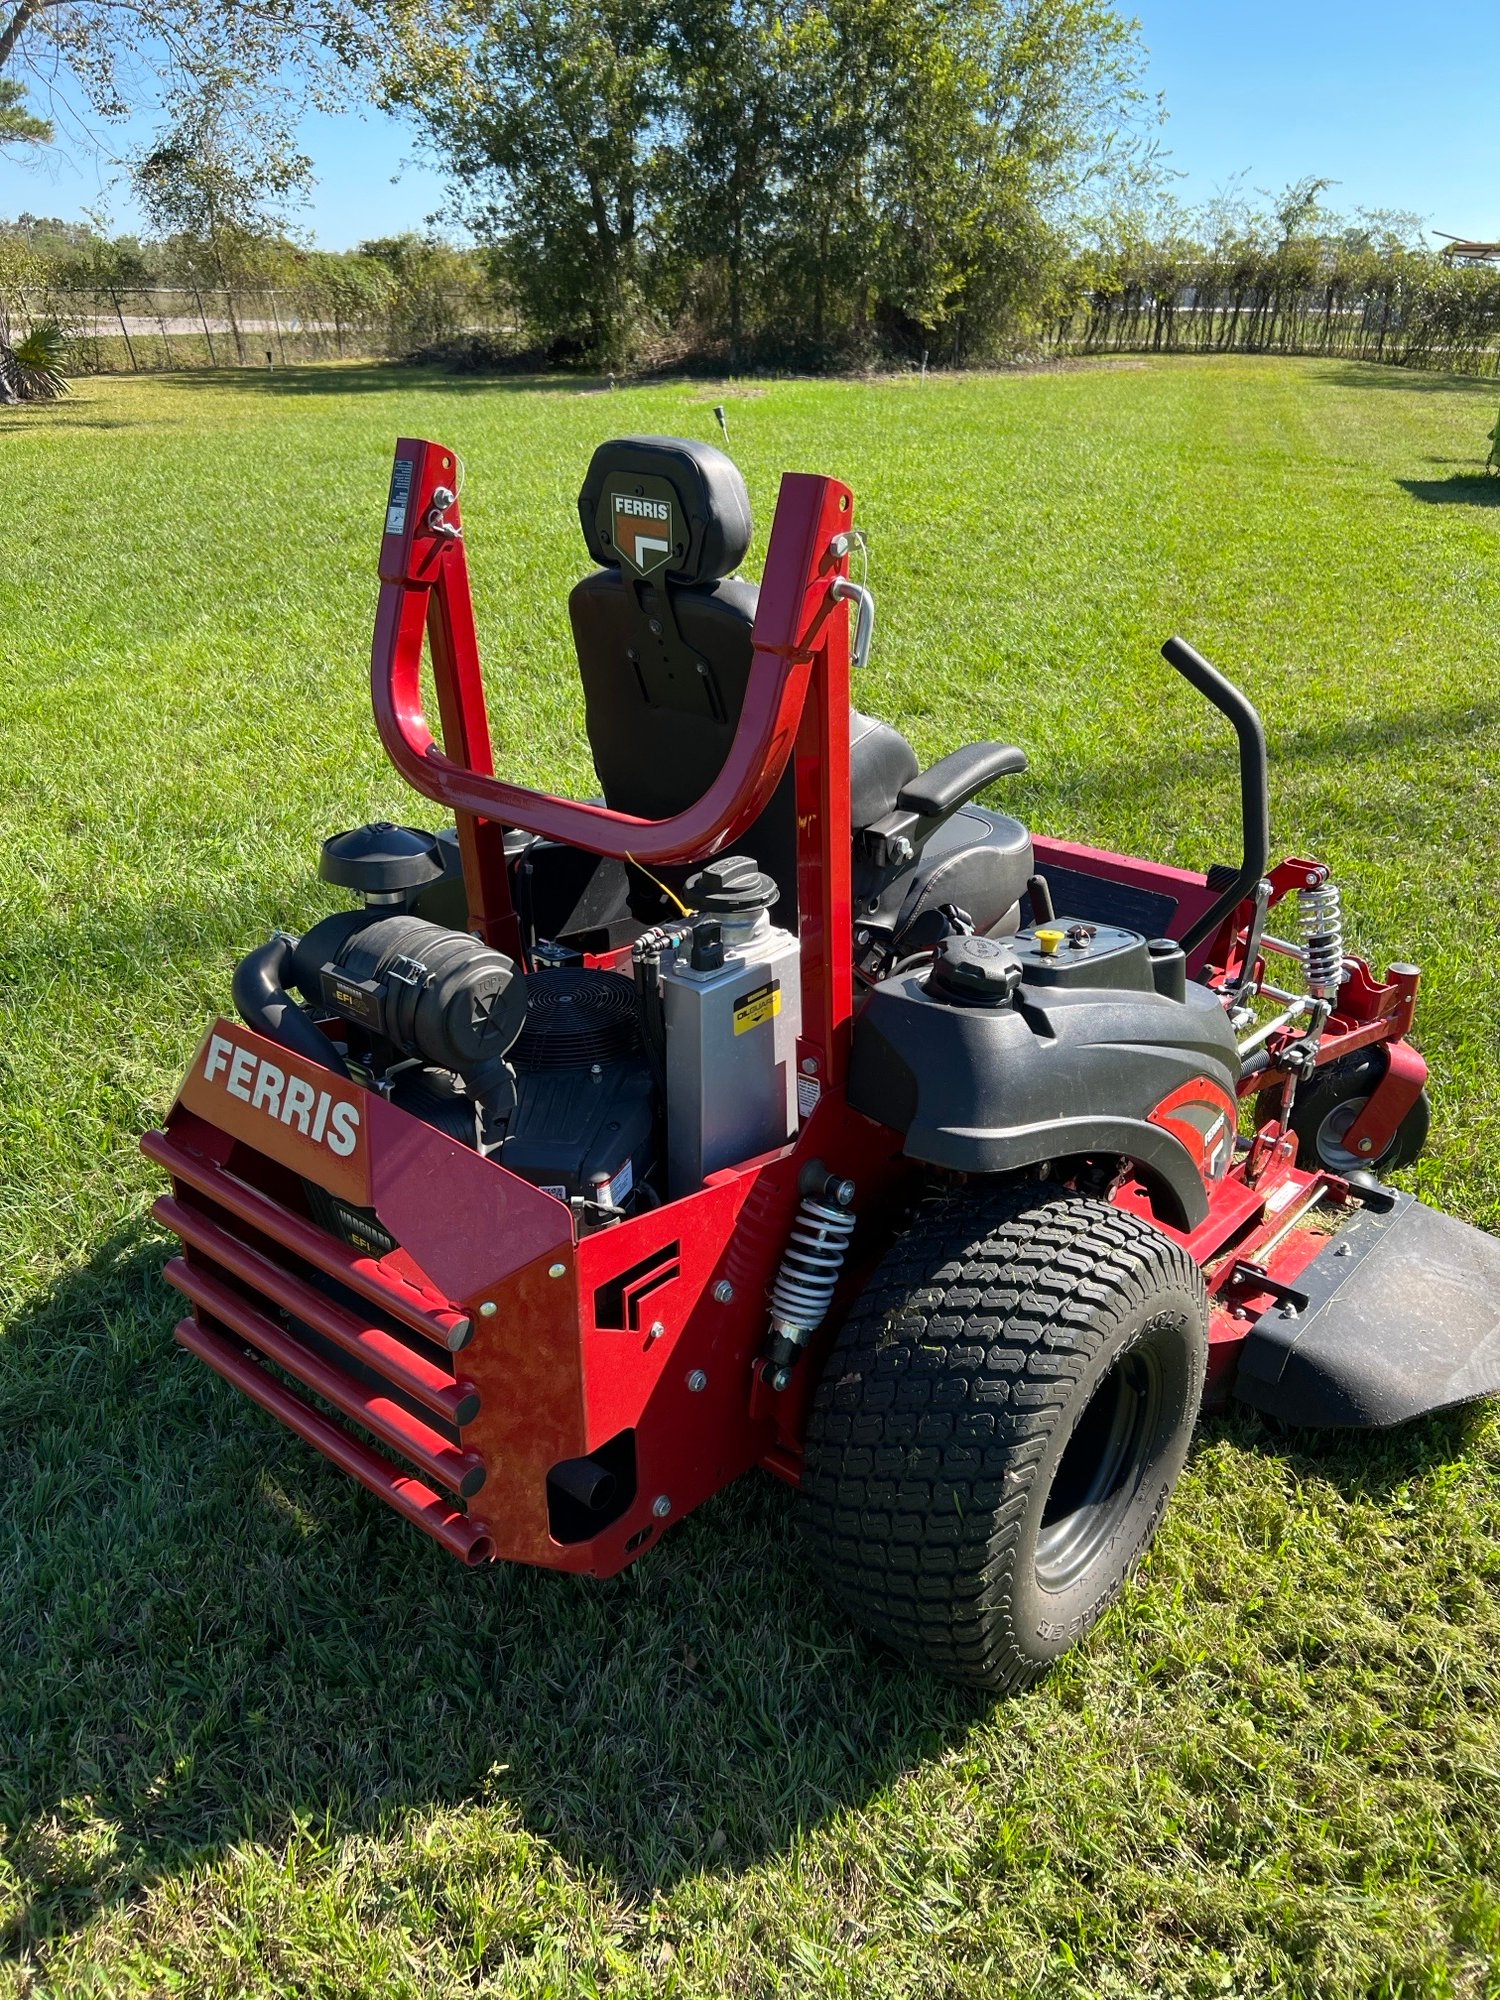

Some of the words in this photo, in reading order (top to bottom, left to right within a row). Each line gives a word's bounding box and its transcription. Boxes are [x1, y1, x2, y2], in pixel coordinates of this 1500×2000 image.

[615, 497, 669, 520] FERRIS
[477, 976, 497, 992] TOP
[336, 990, 353, 1005] EFI
[203, 1034, 360, 1157] FERRIS
[339, 1209, 392, 1250] VANGUARD
[351, 1233, 371, 1251] EFI
